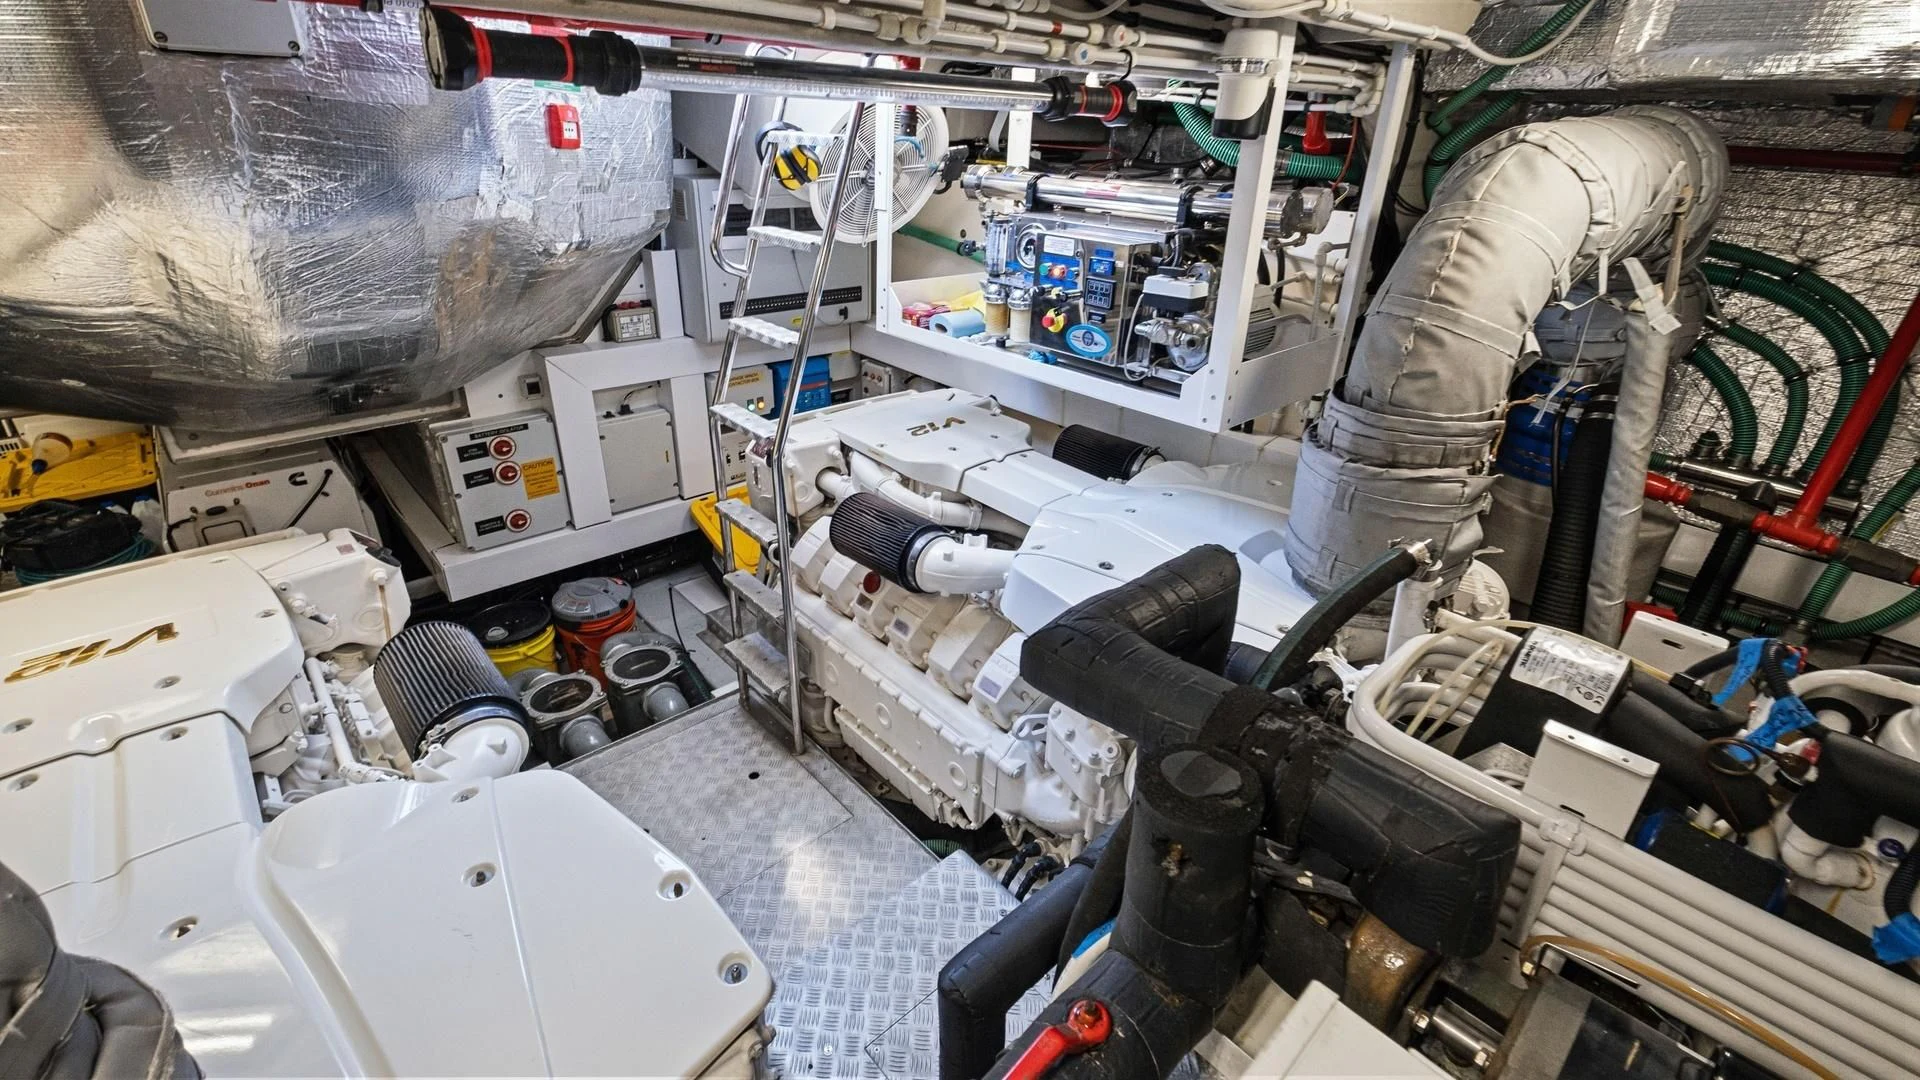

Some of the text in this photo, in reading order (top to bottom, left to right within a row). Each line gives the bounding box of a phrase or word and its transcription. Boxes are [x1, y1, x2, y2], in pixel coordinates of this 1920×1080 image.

[906, 416, 967, 437] V12
[522, 459, 554, 471] CAUTION
[204, 479, 271, 498] Cummins Onan
[3, 622, 180, 684] V12
